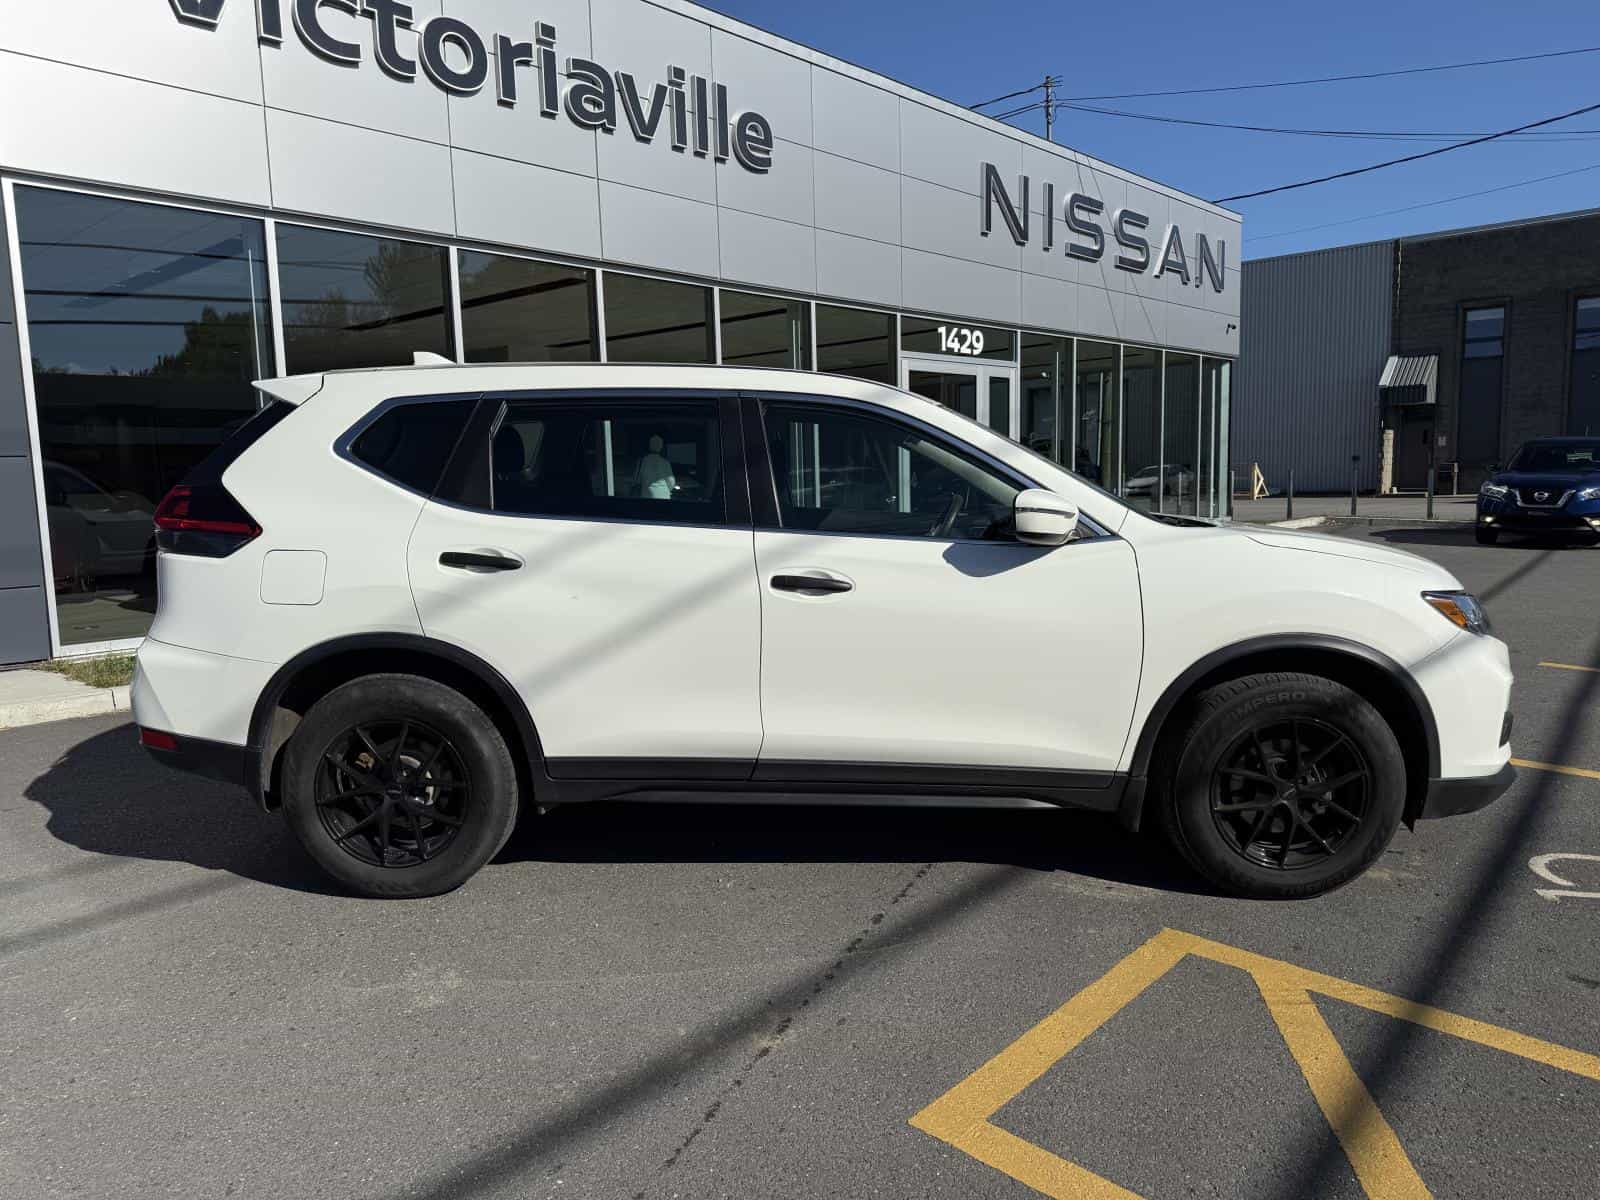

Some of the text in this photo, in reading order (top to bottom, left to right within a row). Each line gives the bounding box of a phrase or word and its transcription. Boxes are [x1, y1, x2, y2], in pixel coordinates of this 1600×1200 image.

[168, 0, 773, 174] ctoriaville
[980, 161, 1226, 293] NISSAN
[937, 326, 984, 356] 1429
